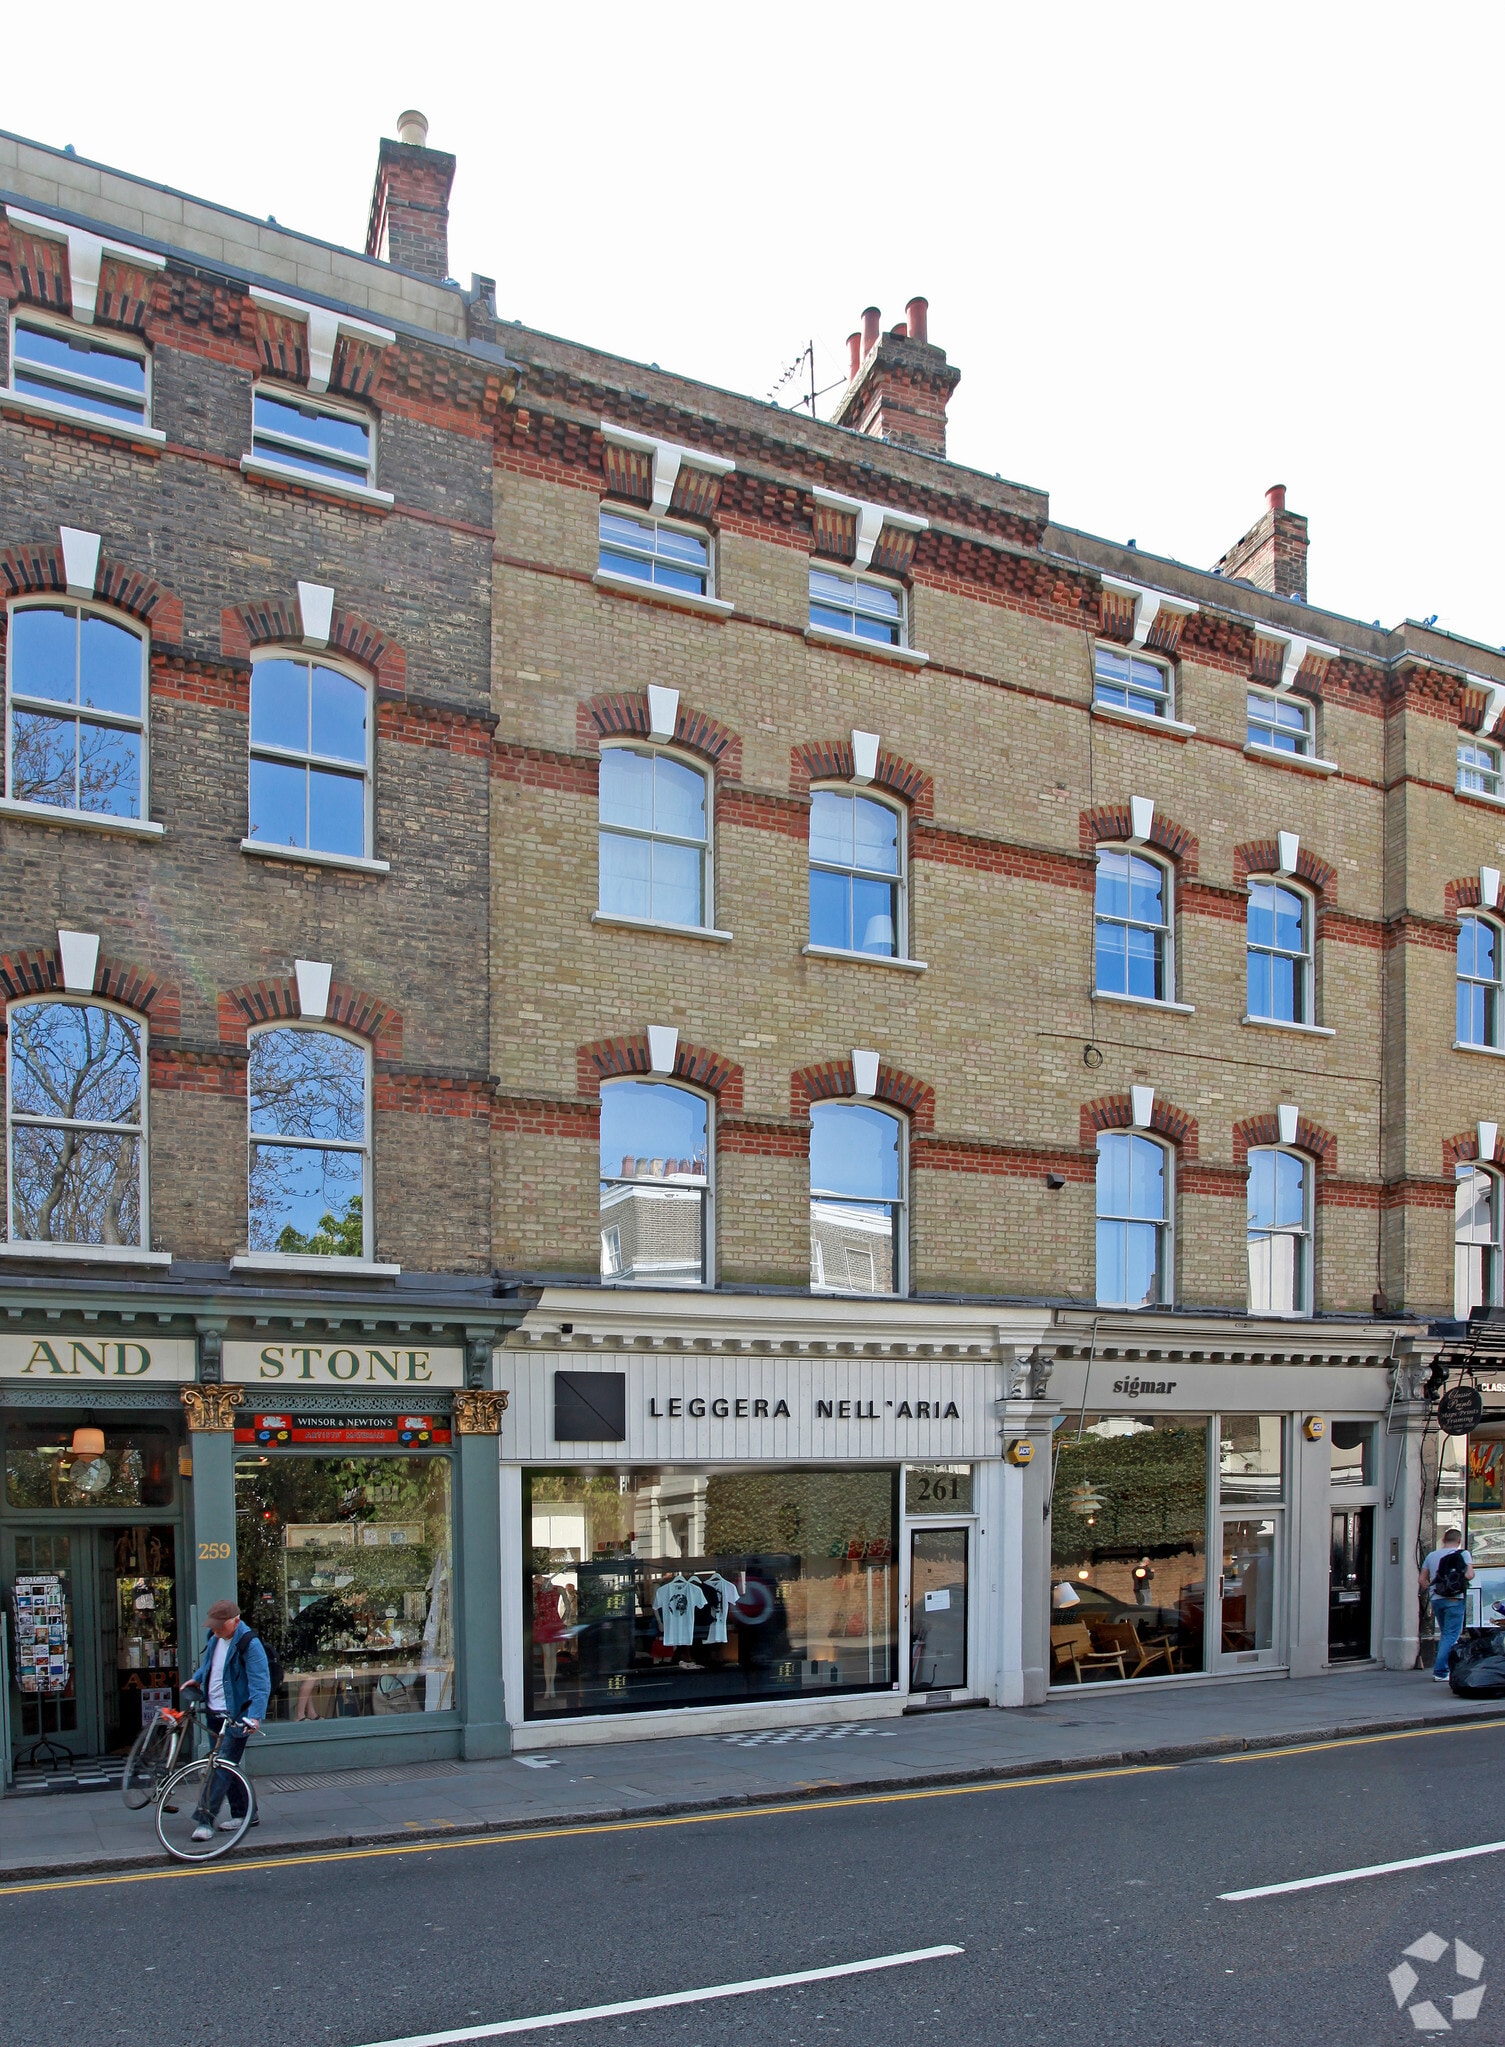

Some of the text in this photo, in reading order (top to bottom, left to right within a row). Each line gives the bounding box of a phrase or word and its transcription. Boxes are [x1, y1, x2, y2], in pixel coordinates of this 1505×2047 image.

[20, 1340, 433, 1382] AND STONE
[1112, 1375, 1178, 1399] sigmar
[650, 1397, 791, 1418] LEGGERA
[297, 1417, 393, 1428] WINSOR & NEWTON'S
[917, 1476, 961, 1501] 261
[198, 1542, 231, 1560] 259
